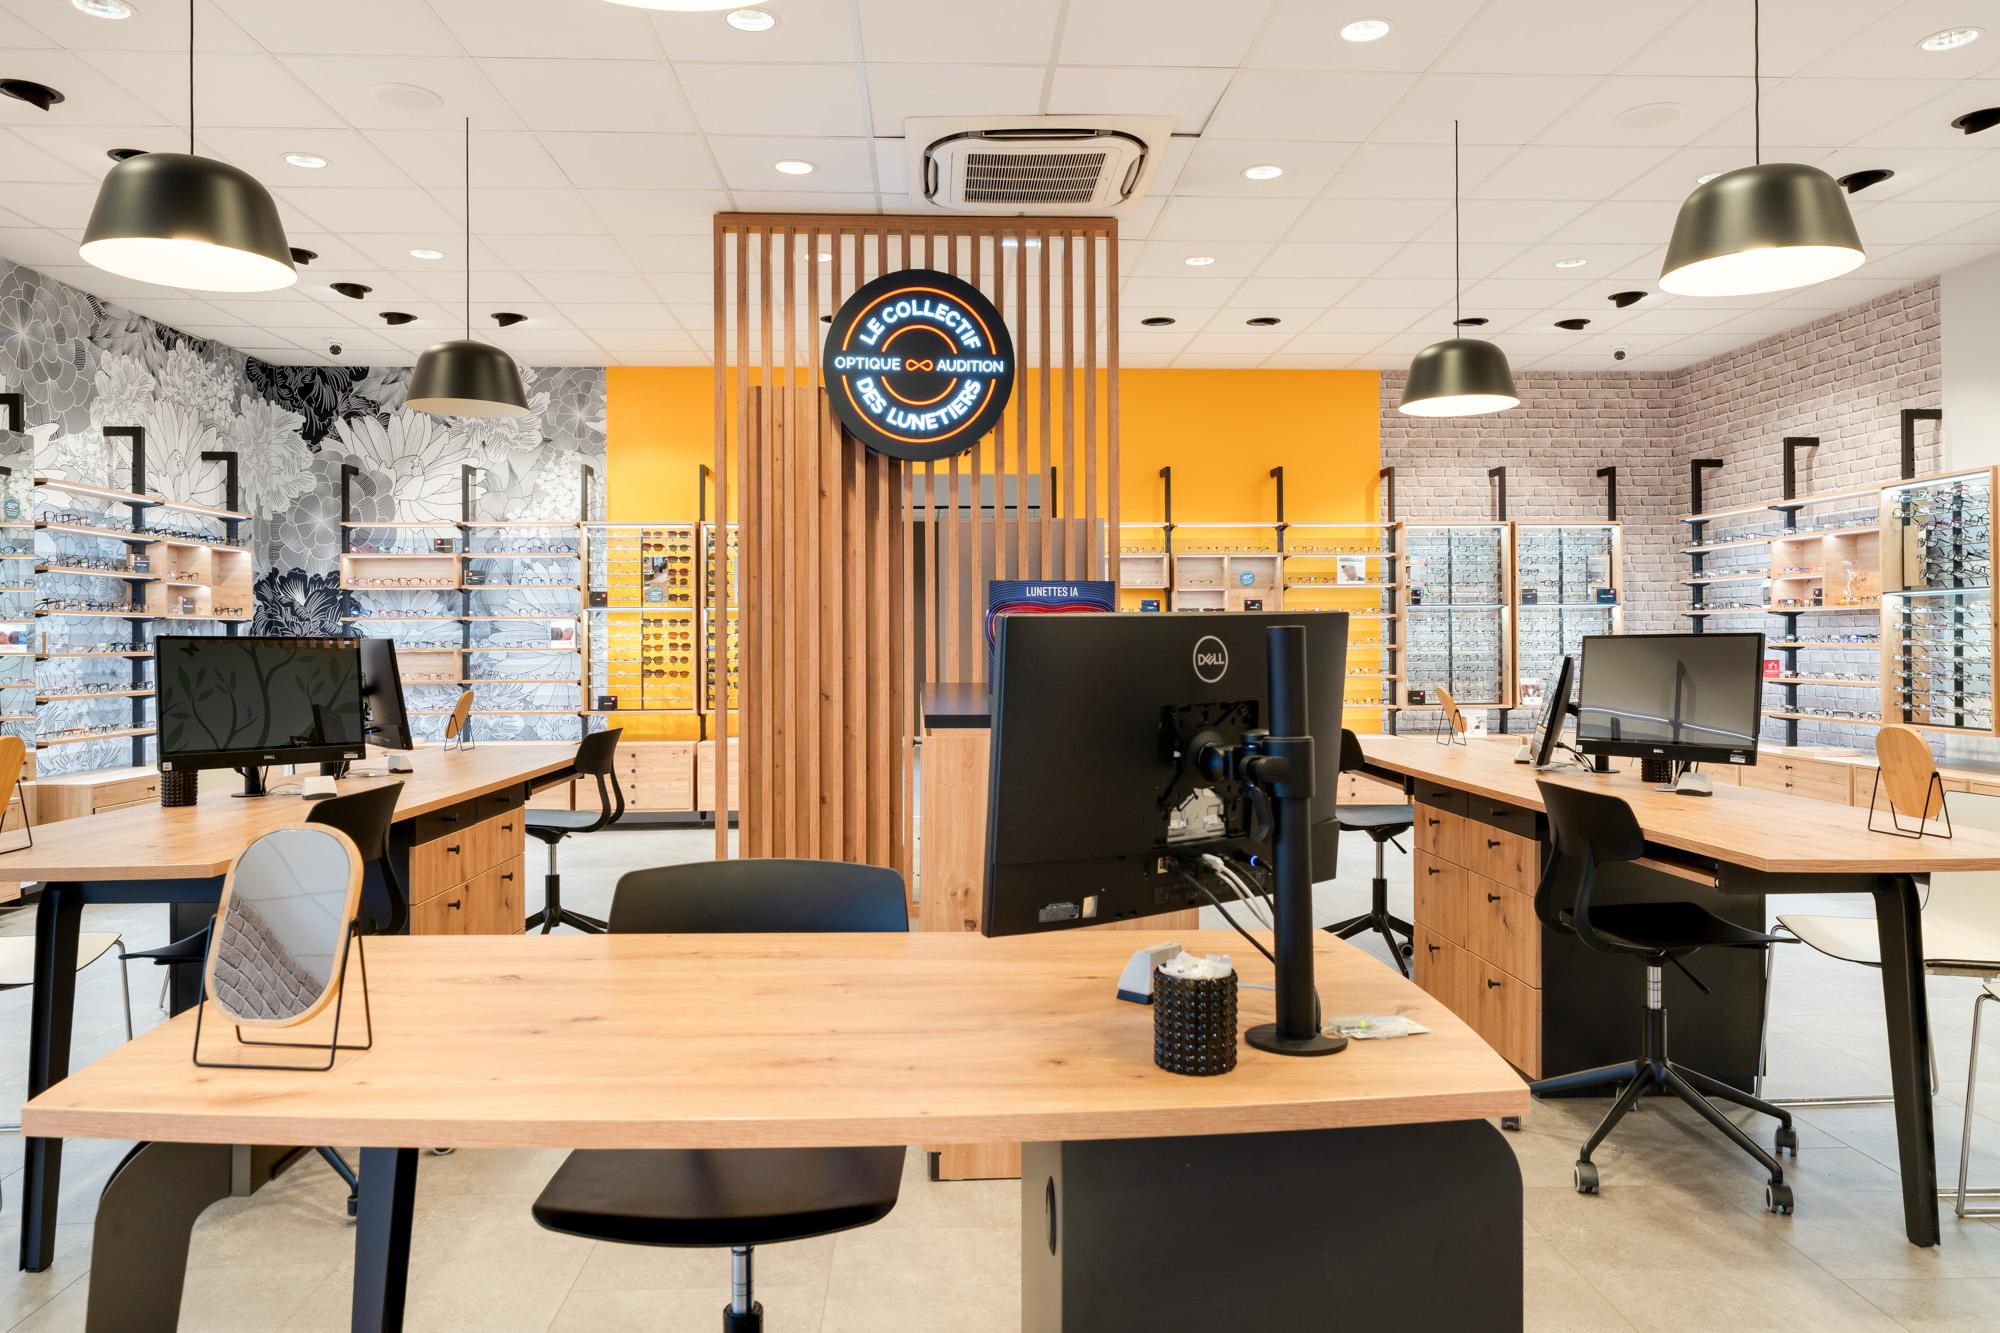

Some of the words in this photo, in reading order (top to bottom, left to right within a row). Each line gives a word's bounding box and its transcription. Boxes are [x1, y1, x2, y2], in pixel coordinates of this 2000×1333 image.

[859, 318, 885, 346] LE
[882, 299, 981, 350] COLLECTIF
[834, 356, 901, 370] OPTIQUE
[936, 359, 1004, 373] AUDITION
[856, 377, 887, 414] DES
[886, 379, 981, 430] LUNETIERS
[1026, 586, 1068, 597] LUNETTES
[1070, 586, 1079, 597] IA
[1198, 653, 1225, 666] DELL
